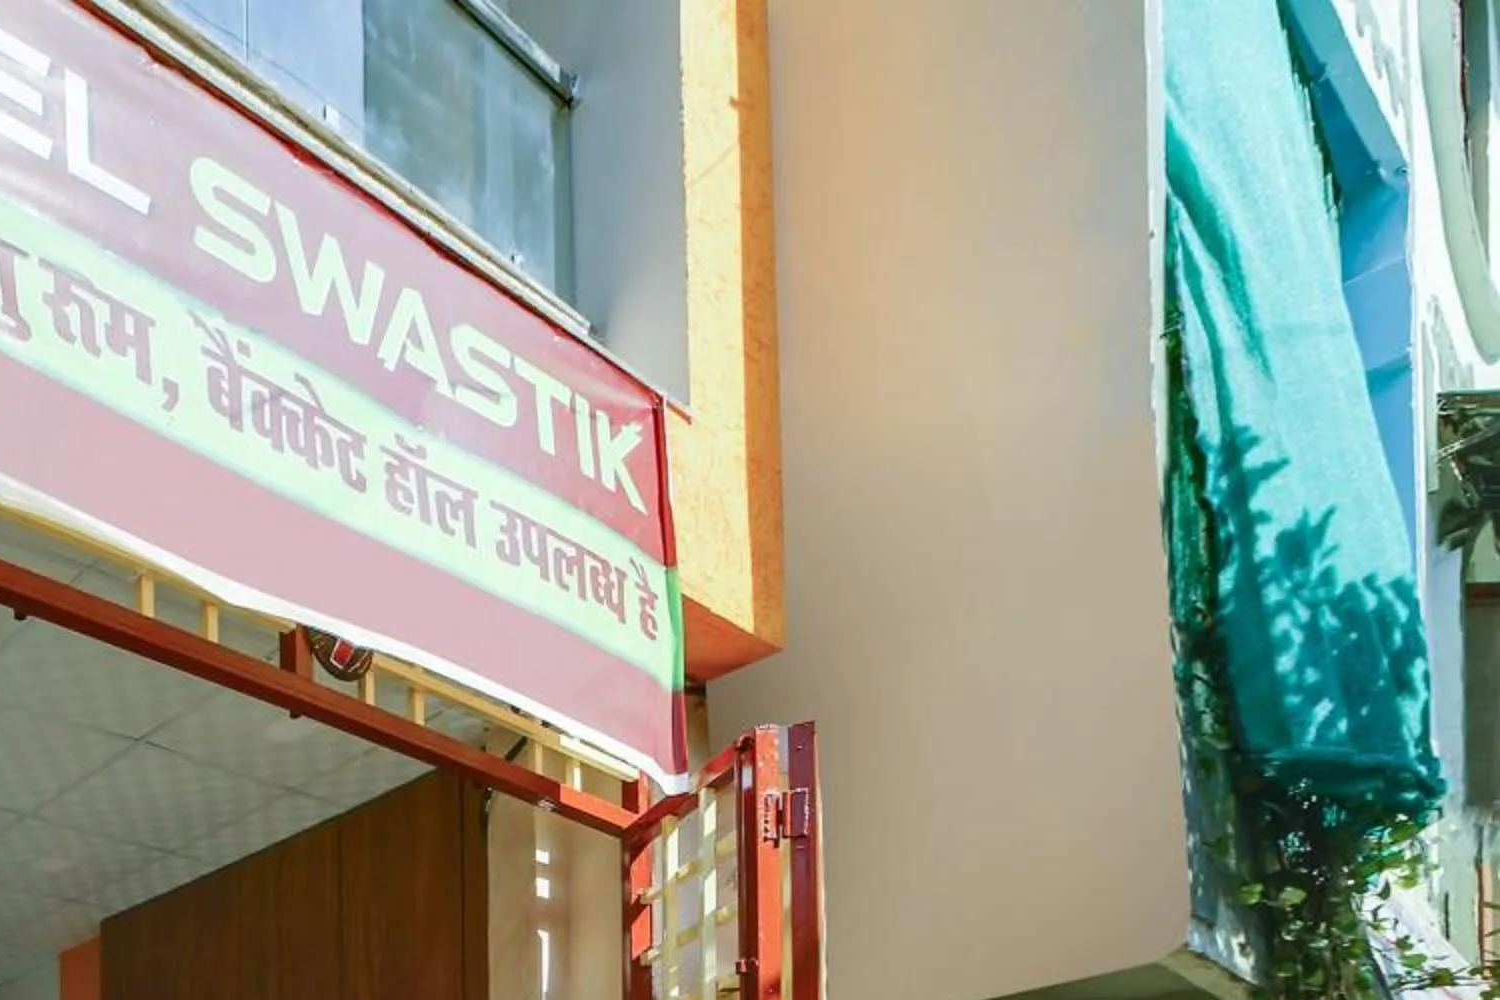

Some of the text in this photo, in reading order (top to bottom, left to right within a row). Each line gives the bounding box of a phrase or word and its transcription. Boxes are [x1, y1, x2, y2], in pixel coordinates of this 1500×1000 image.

[189, 156, 648, 516] SWASTIK
[378, 431, 479, 549] हॉल
[629, 556, 659, 641] है
